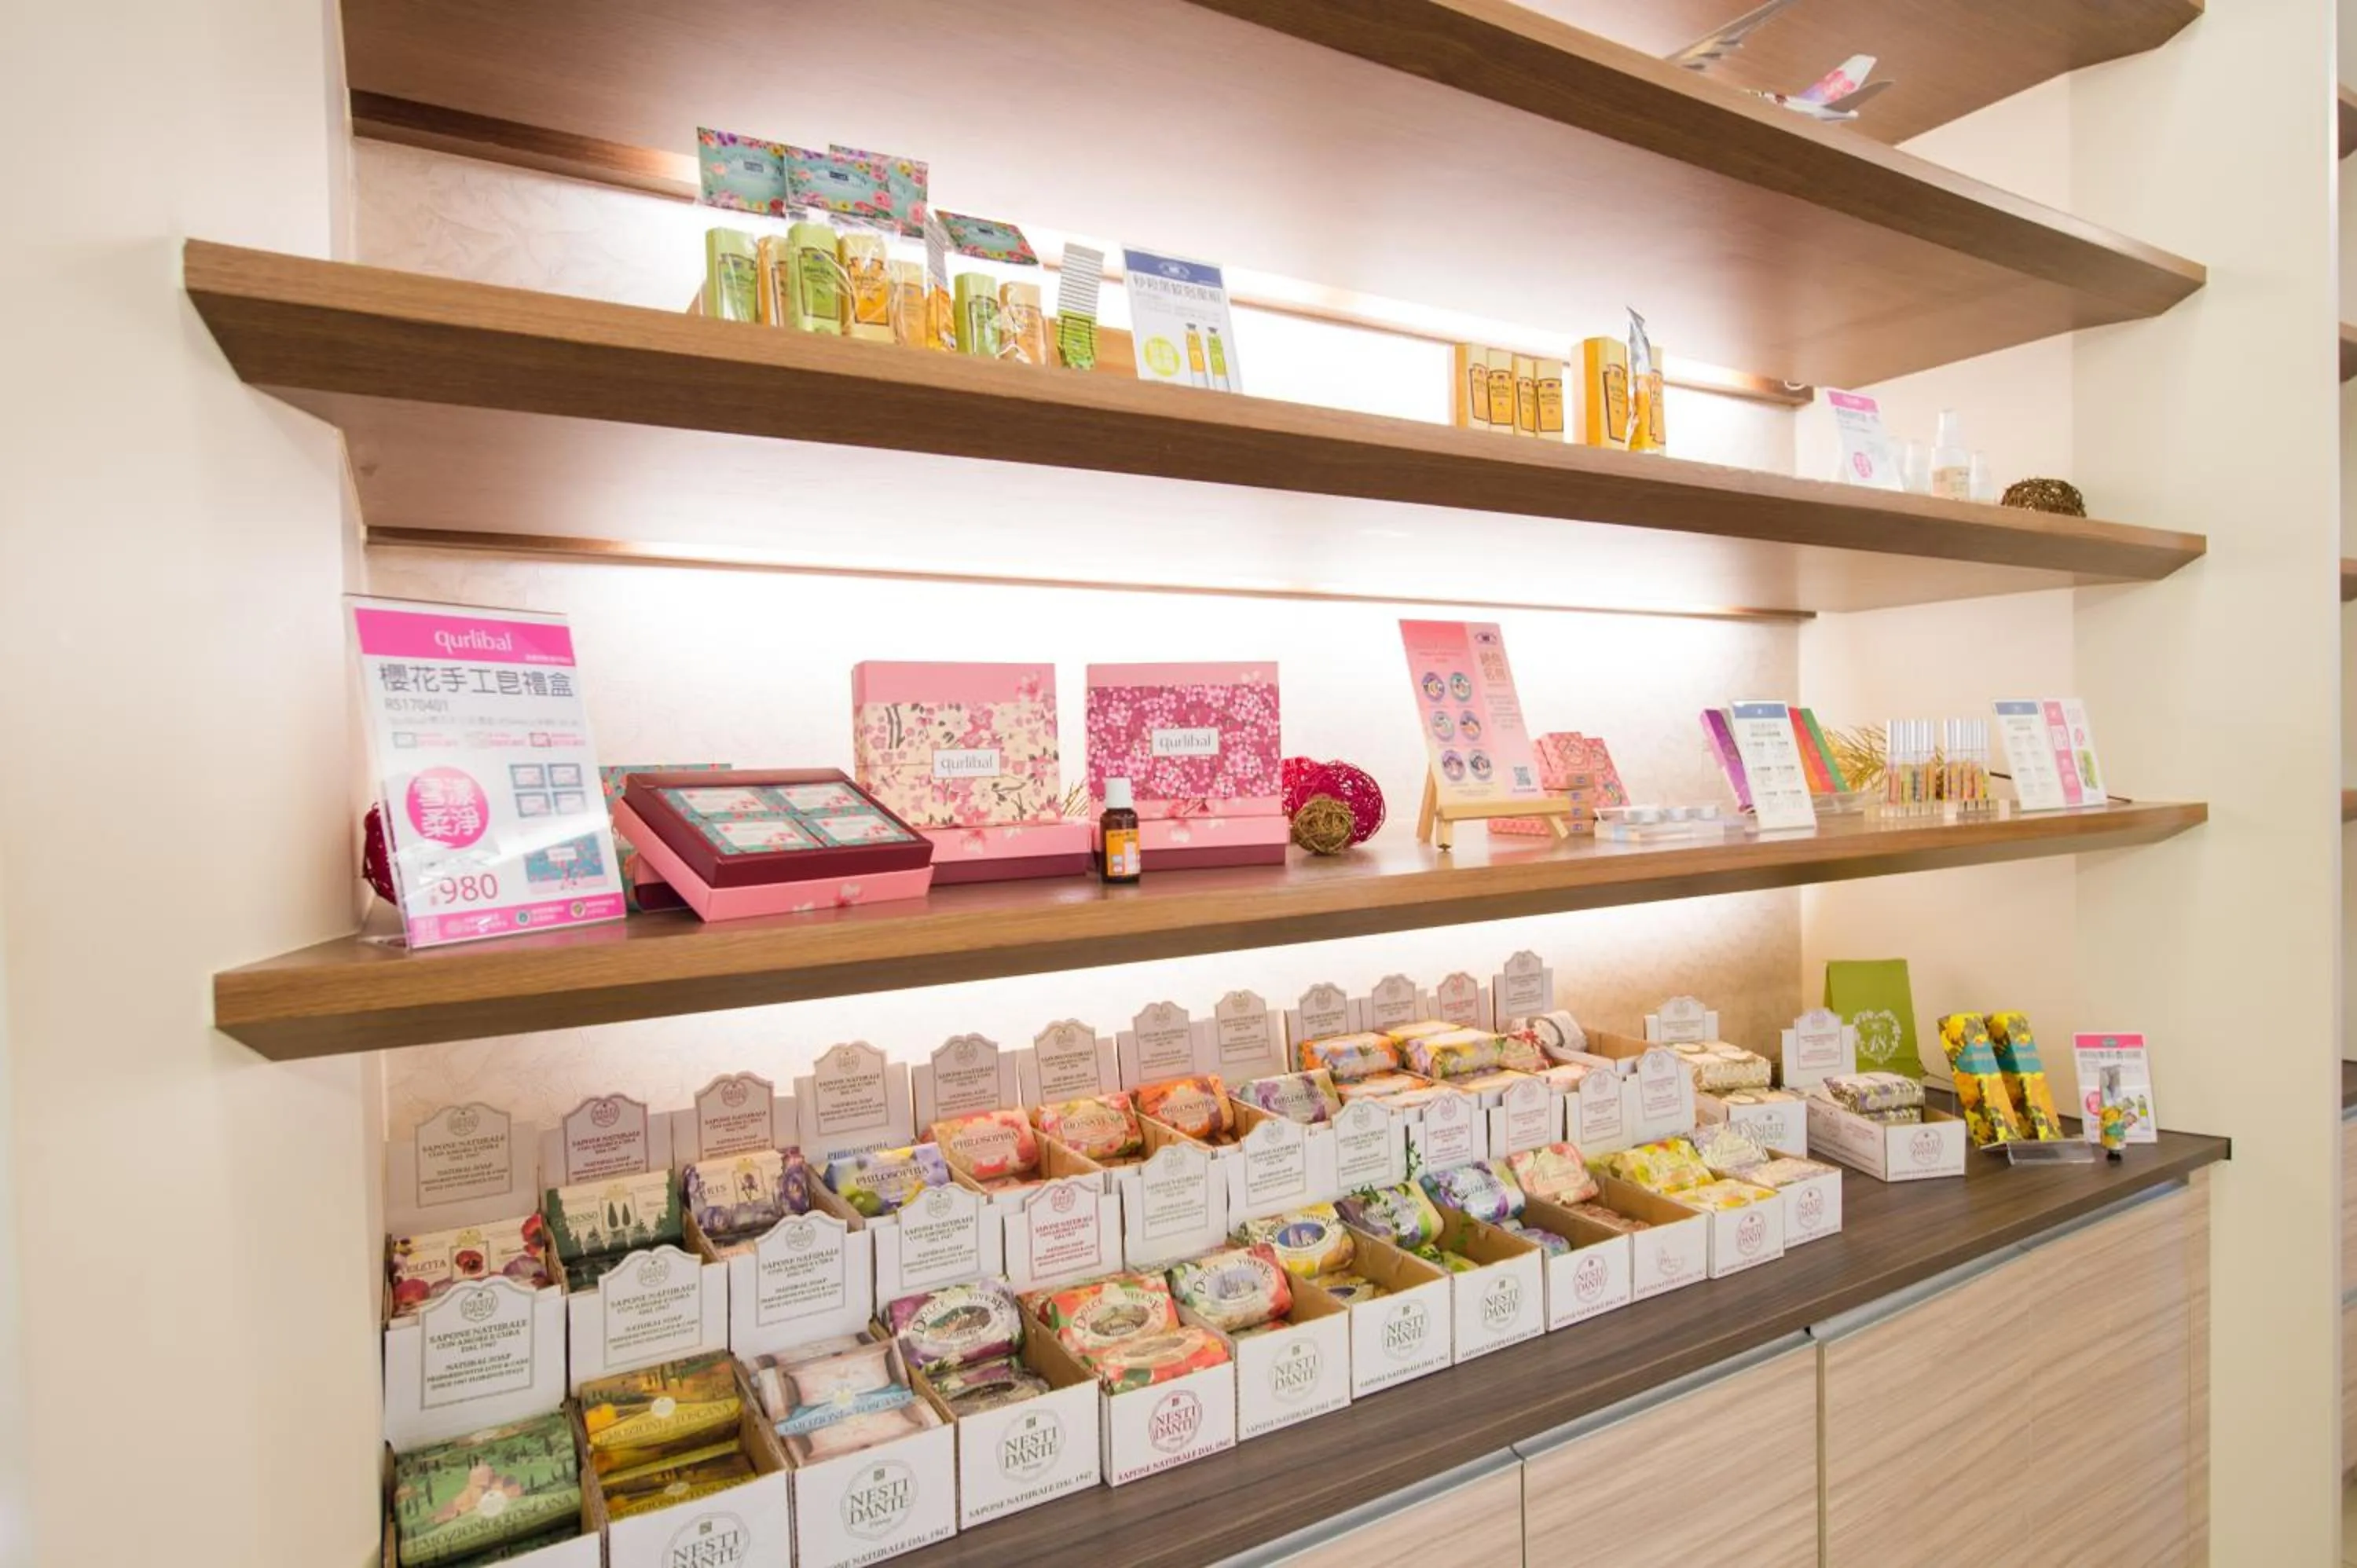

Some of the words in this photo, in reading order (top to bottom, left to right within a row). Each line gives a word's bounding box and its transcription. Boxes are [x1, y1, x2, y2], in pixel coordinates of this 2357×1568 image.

[434, 629, 512, 654] qurlibal
[379, 664, 574, 697] 櫻花手工皂禮盒
[1159, 734, 1211, 750] qurlibal
[940, 755, 994, 771] qurlibal
[429, 1329, 471, 1344] SAPONE
[473, 1319, 527, 1335] NATURALE
[445, 1357, 486, 1371] NATURAL
[489, 1354, 511, 1364] SOAP
[1274, 1355, 1316, 1376] NESTI
[1157, 1405, 1195, 1425] NESTI
[1005, 1426, 1057, 1452] NESTI
[1155, 1418, 1193, 1440] DANTE
[1005, 1442, 1057, 1468] DANTE
[850, 1478, 908, 1509] NESTI
[969, 1500, 1004, 1518] SAPONE
[1006, 1483, 1054, 1505] NATURALE
[1056, 1478, 1073, 1489] DAL
[851, 1495, 910, 1524] DANTE
[673, 1530, 739, 1563] NESTI
[852, 1542, 905, 1566] NATURALE
[908, 1533, 926, 1548] DAL
